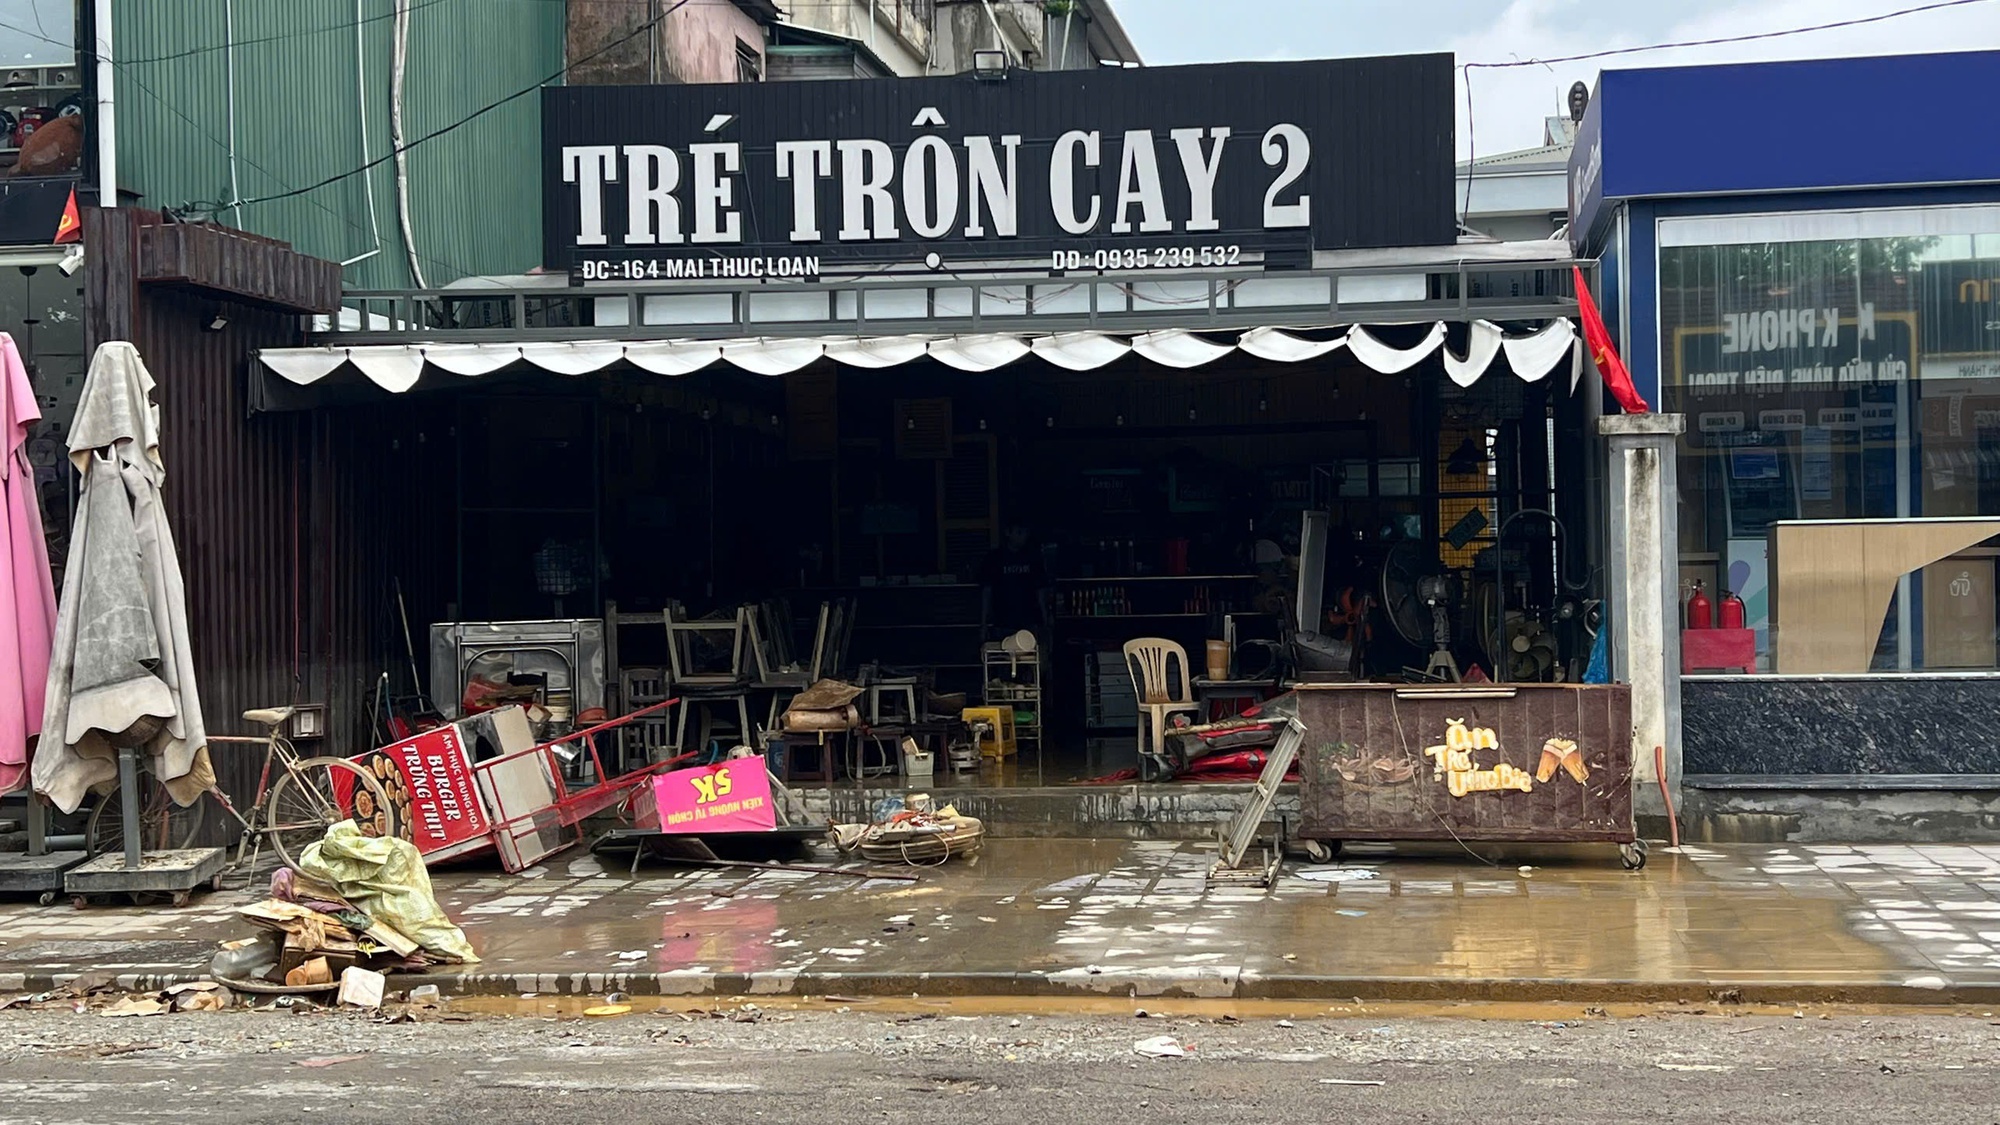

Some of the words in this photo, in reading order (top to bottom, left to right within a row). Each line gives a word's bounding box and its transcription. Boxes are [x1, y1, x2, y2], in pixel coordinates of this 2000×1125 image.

[563, 114, 741, 246] TRÉ
[1050, 127, 1231, 235] CAY
[1261, 123, 1311, 229] 2
[666, 258, 704, 278] MAI
[709, 257, 763, 277] THUC
[767, 256, 820, 276] LOAN
[1154, 246, 1194, 267] 239
[1200, 245, 1240, 266] 532
[426, 754, 462, 821] BURGER
[456, 776, 473, 810] TRUNG
[467, 808, 480, 830] HOA
[690, 767, 733, 805] 5K
